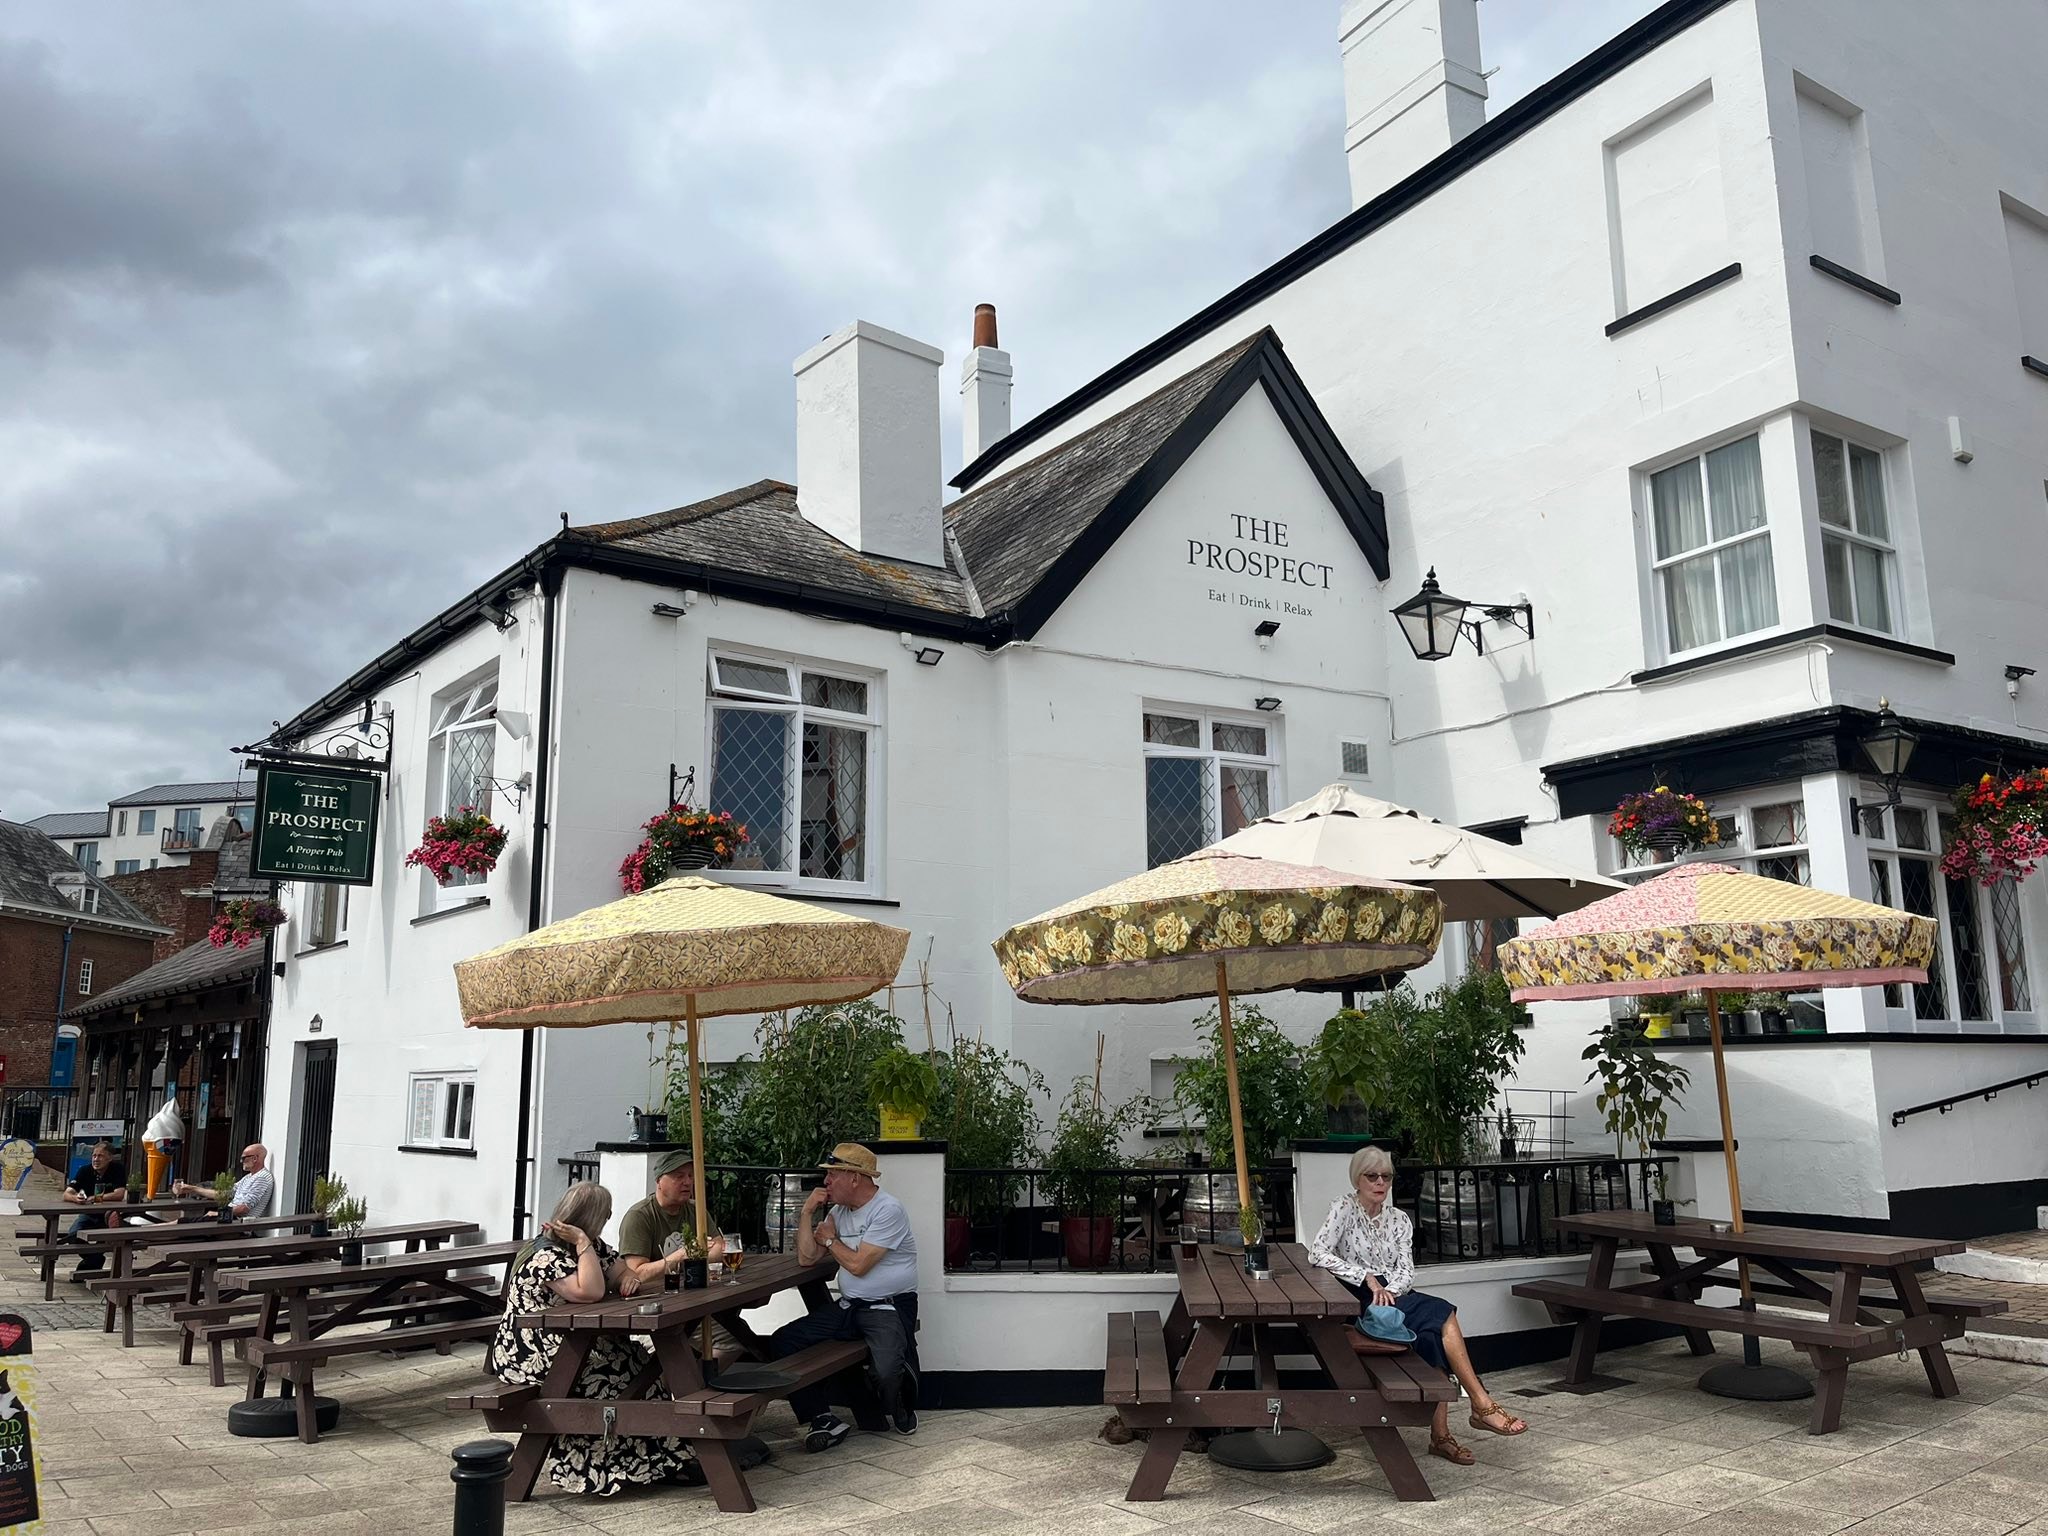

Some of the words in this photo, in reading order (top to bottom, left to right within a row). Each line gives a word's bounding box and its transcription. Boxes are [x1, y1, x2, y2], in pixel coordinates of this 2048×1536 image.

[1231, 513, 1289, 547] THE
[1187, 539, 1333, 589] PROSPECT
[1208, 589, 1227, 602] Eat
[1239, 594, 1271, 610] Drink
[1284, 602, 1313, 616] Relax
[301, 793, 338, 809] THE
[267, 811, 366, 832] PROSPECT
[286, 845, 294, 853] A
[296, 845, 325, 856] Proper
[326, 848, 344, 857] Pub
[275, 861, 289, 869] Eat
[297, 863, 321, 871] Drink
[329, 865, 351, 873] Relax
[0, 1419, 22, 1435] OD
[0, 1434, 24, 1447] THY
[0, 1445, 23, 1465] TY
[5, 1461, 28, 1472] DOGS
